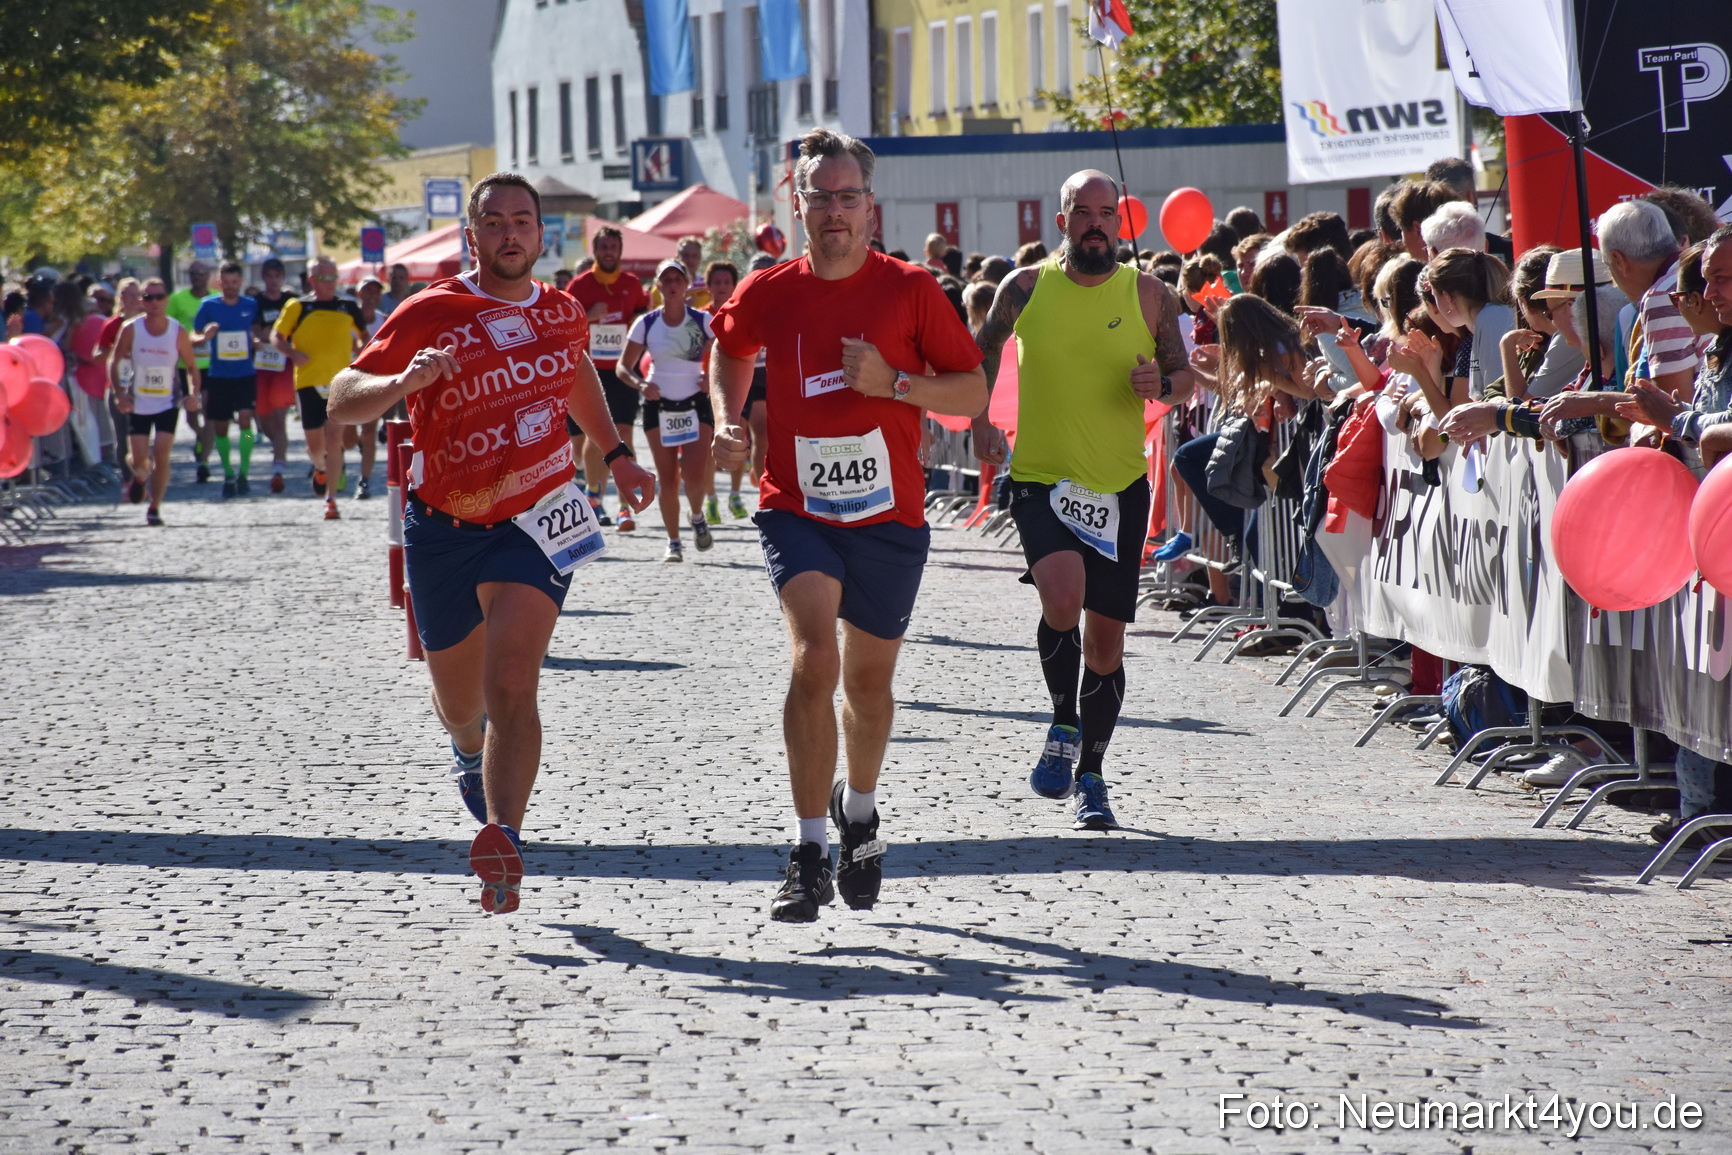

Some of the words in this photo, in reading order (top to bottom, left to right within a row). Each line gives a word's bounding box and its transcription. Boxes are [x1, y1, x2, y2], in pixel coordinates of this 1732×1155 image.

[1645, 54, 1673, 63] Team
[595, 334, 622, 346] 2440
[488, 388, 533, 409] wohnen
[820, 443, 863, 456] BOCK
[809, 457, 878, 488] 2448
[819, 490, 840, 498] PARTL
[840, 487, 868, 496] Neumarkt
[1069, 484, 1103, 500] BOCK
[829, 499, 868, 514] Philipp
[1060, 496, 1110, 530] 2633
[537, 498, 589, 541] 2222
